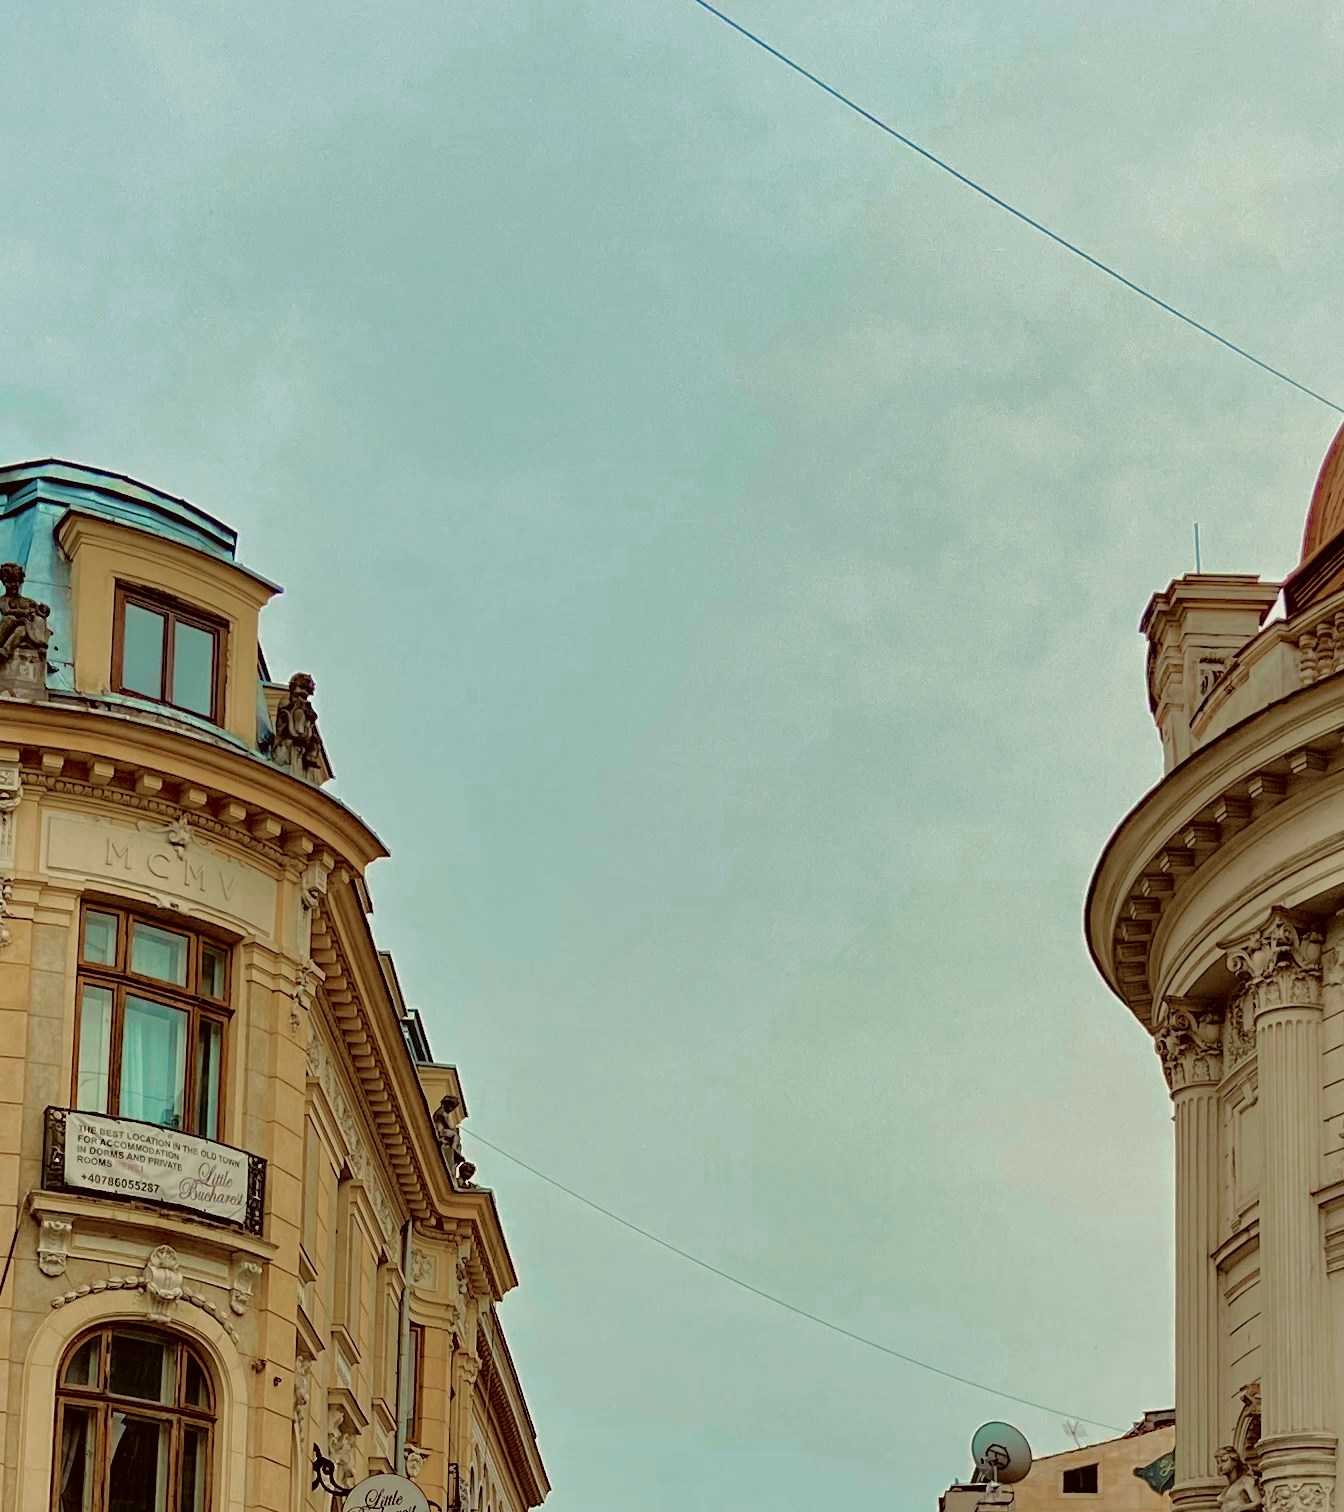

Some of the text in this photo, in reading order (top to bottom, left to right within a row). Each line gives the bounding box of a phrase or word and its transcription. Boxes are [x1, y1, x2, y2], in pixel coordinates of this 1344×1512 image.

[77, 1145, 183, 1172] IN DORMS AND PRIVATE
[78, 1135, 180, 1161] FOR ACCOMMODATION
[79, 1125, 240, 1168] THE BEST LOCATION IN THE OLD TOWN
[77, 1155, 112, 1168] ROOMS
[81, 1173, 160, 1194] +40786055287
[198, 1162, 233, 1188] Little
[179, 1177, 244, 1206] Bucharest
[365, 1488, 404, 1509] Little
